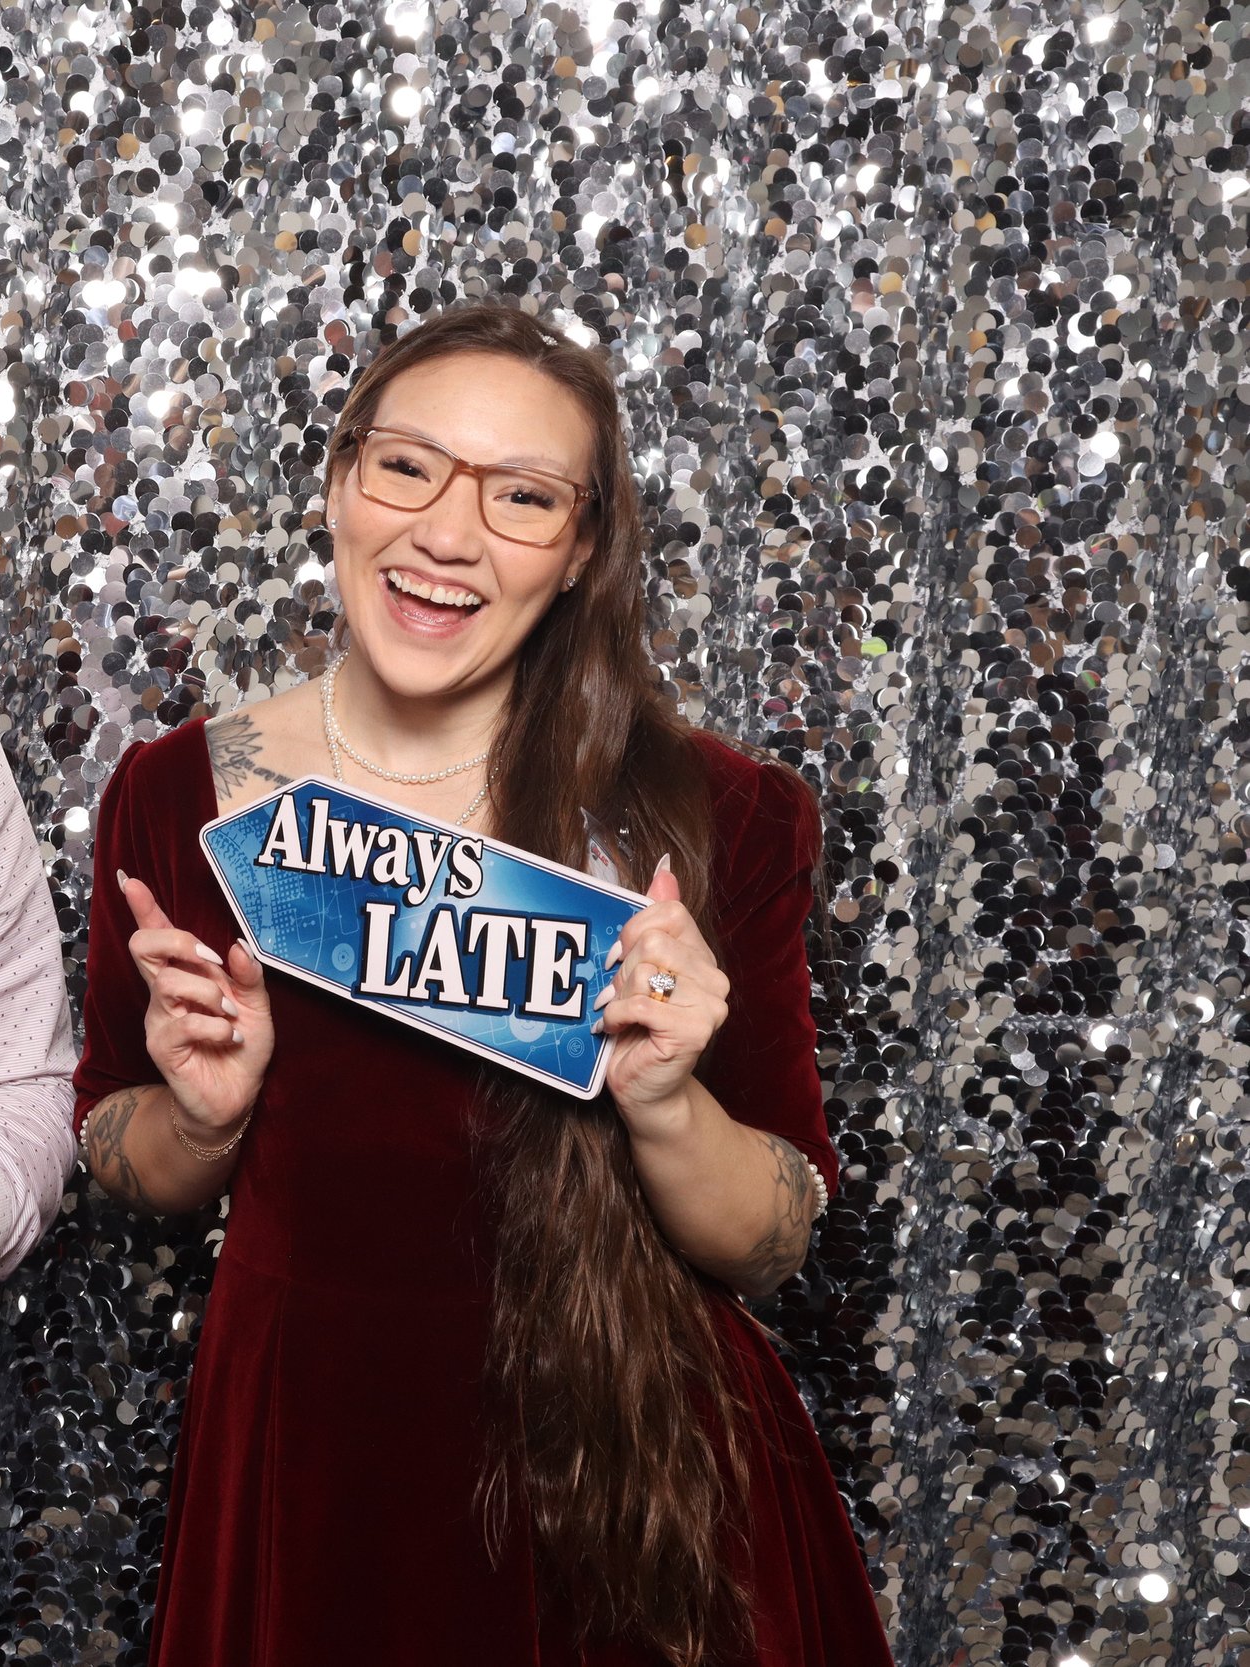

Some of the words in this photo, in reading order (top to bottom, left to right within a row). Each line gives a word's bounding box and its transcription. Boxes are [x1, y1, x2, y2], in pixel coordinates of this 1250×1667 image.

[221, 746, 255, 771] You
[253, 767, 276, 781] are
[256, 793, 483, 906] Always
[355, 901, 589, 1019] LATE
